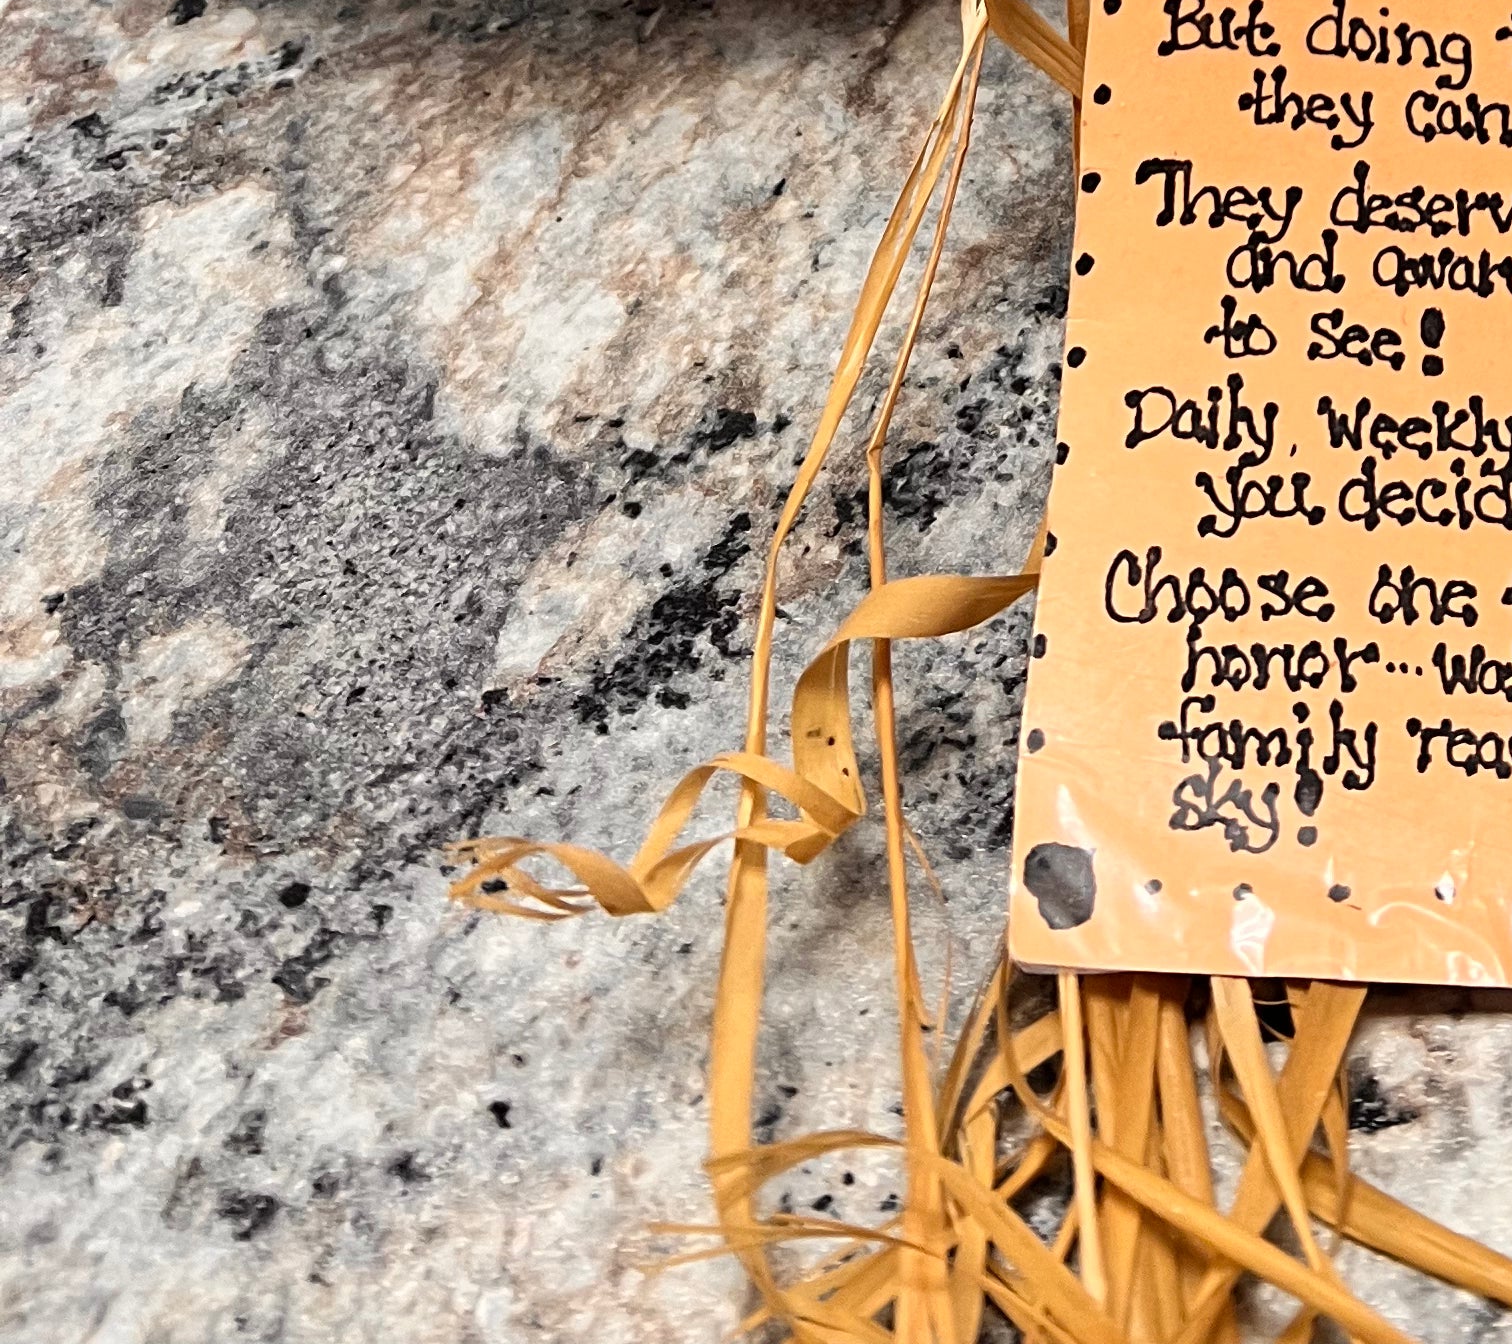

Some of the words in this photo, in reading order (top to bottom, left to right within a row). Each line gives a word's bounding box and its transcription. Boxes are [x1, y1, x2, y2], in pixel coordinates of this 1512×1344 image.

[1239, 66, 1375, 149] they
[1135, 158, 1302, 243] They
[1226, 227, 1345, 293] and
[1204, 295, 1276, 358] to
[1196, 464, 1326, 537] you
[1105, 544, 1334, 623] Choose
[1368, 564, 1478, 626] one
[1157, 695, 1377, 790] family
[1168, 759, 1324, 852] sky!
